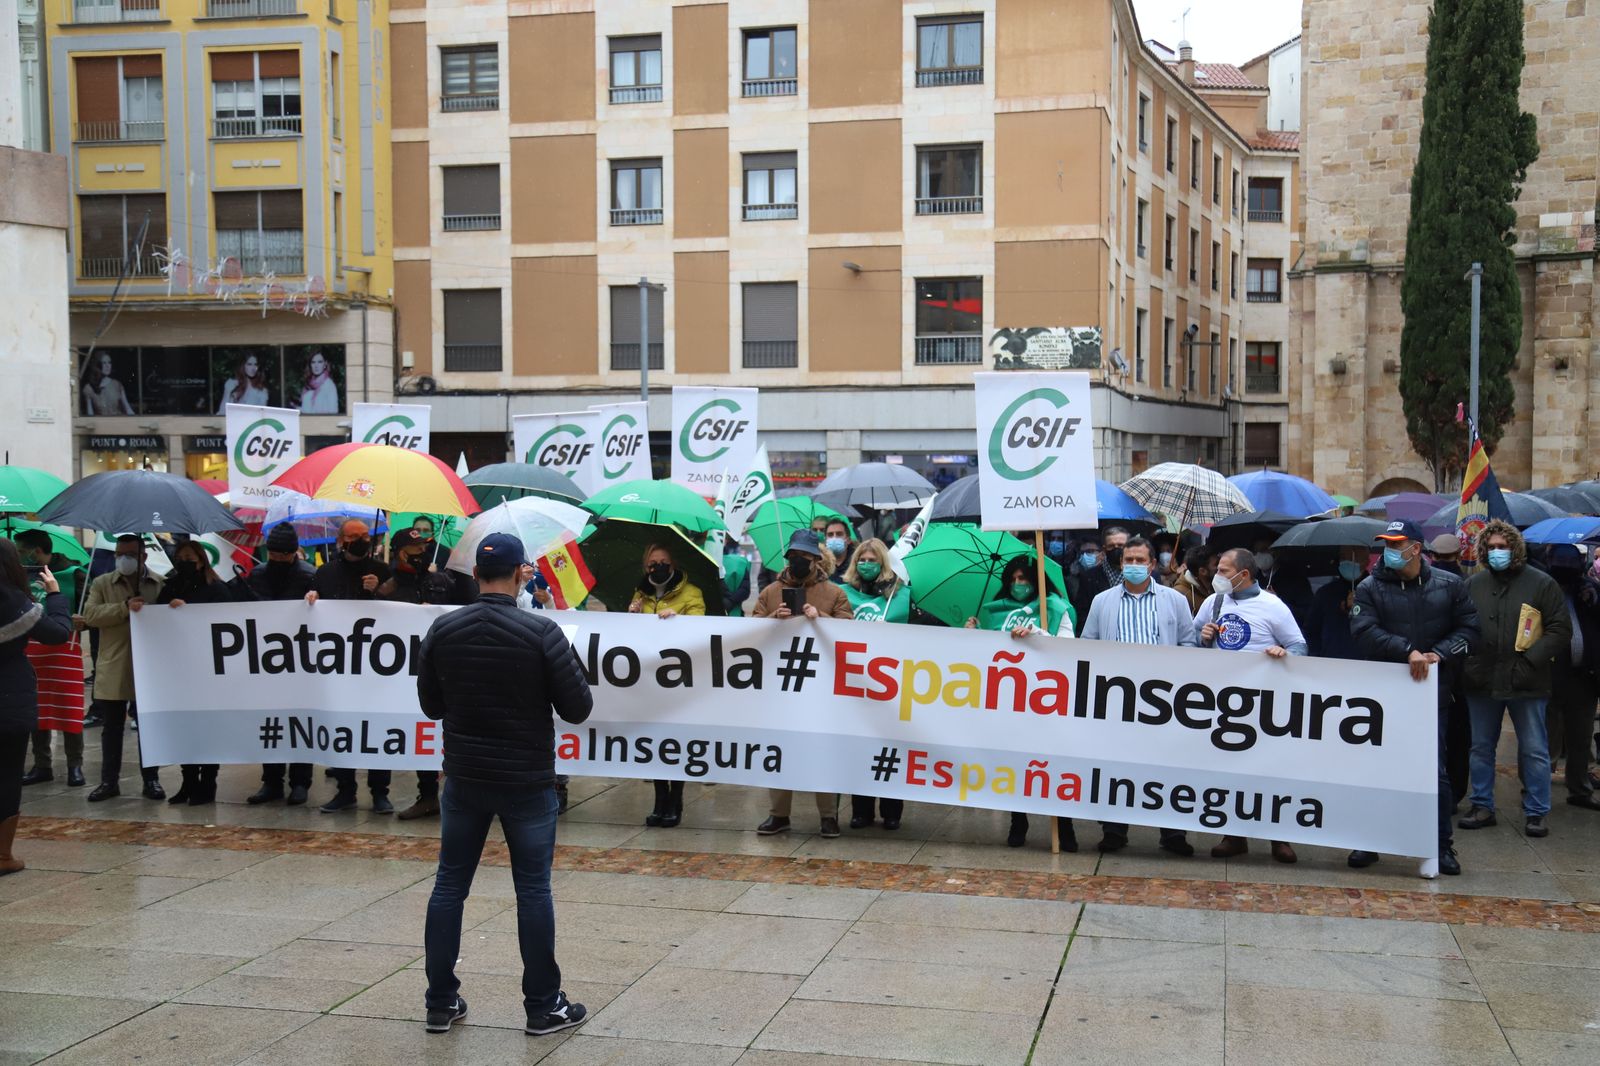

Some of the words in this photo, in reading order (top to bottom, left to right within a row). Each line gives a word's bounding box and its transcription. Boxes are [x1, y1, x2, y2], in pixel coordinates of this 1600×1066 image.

[692, 417, 750, 442] CSIF
[1006, 415, 1082, 449] CSIF
[91, 438, 116, 448] PUNT
[129, 438, 158, 448] ROMA
[196, 438, 222, 448] PUNT
[246, 435, 293, 460] CSIF
[538, 441, 596, 467] CSIF
[605, 433, 644, 458] CSIF
[242, 486, 285, 499] ZAMOR
[1003, 494, 1076, 510] ZAMORA
[1006, 615, 1037, 629] CSIF
[570, 633, 641, 688] No
[655, 648, 694, 688] a
[710, 634, 763, 690] la
[870, 746, 1325, 829] #EspañaInsegura
